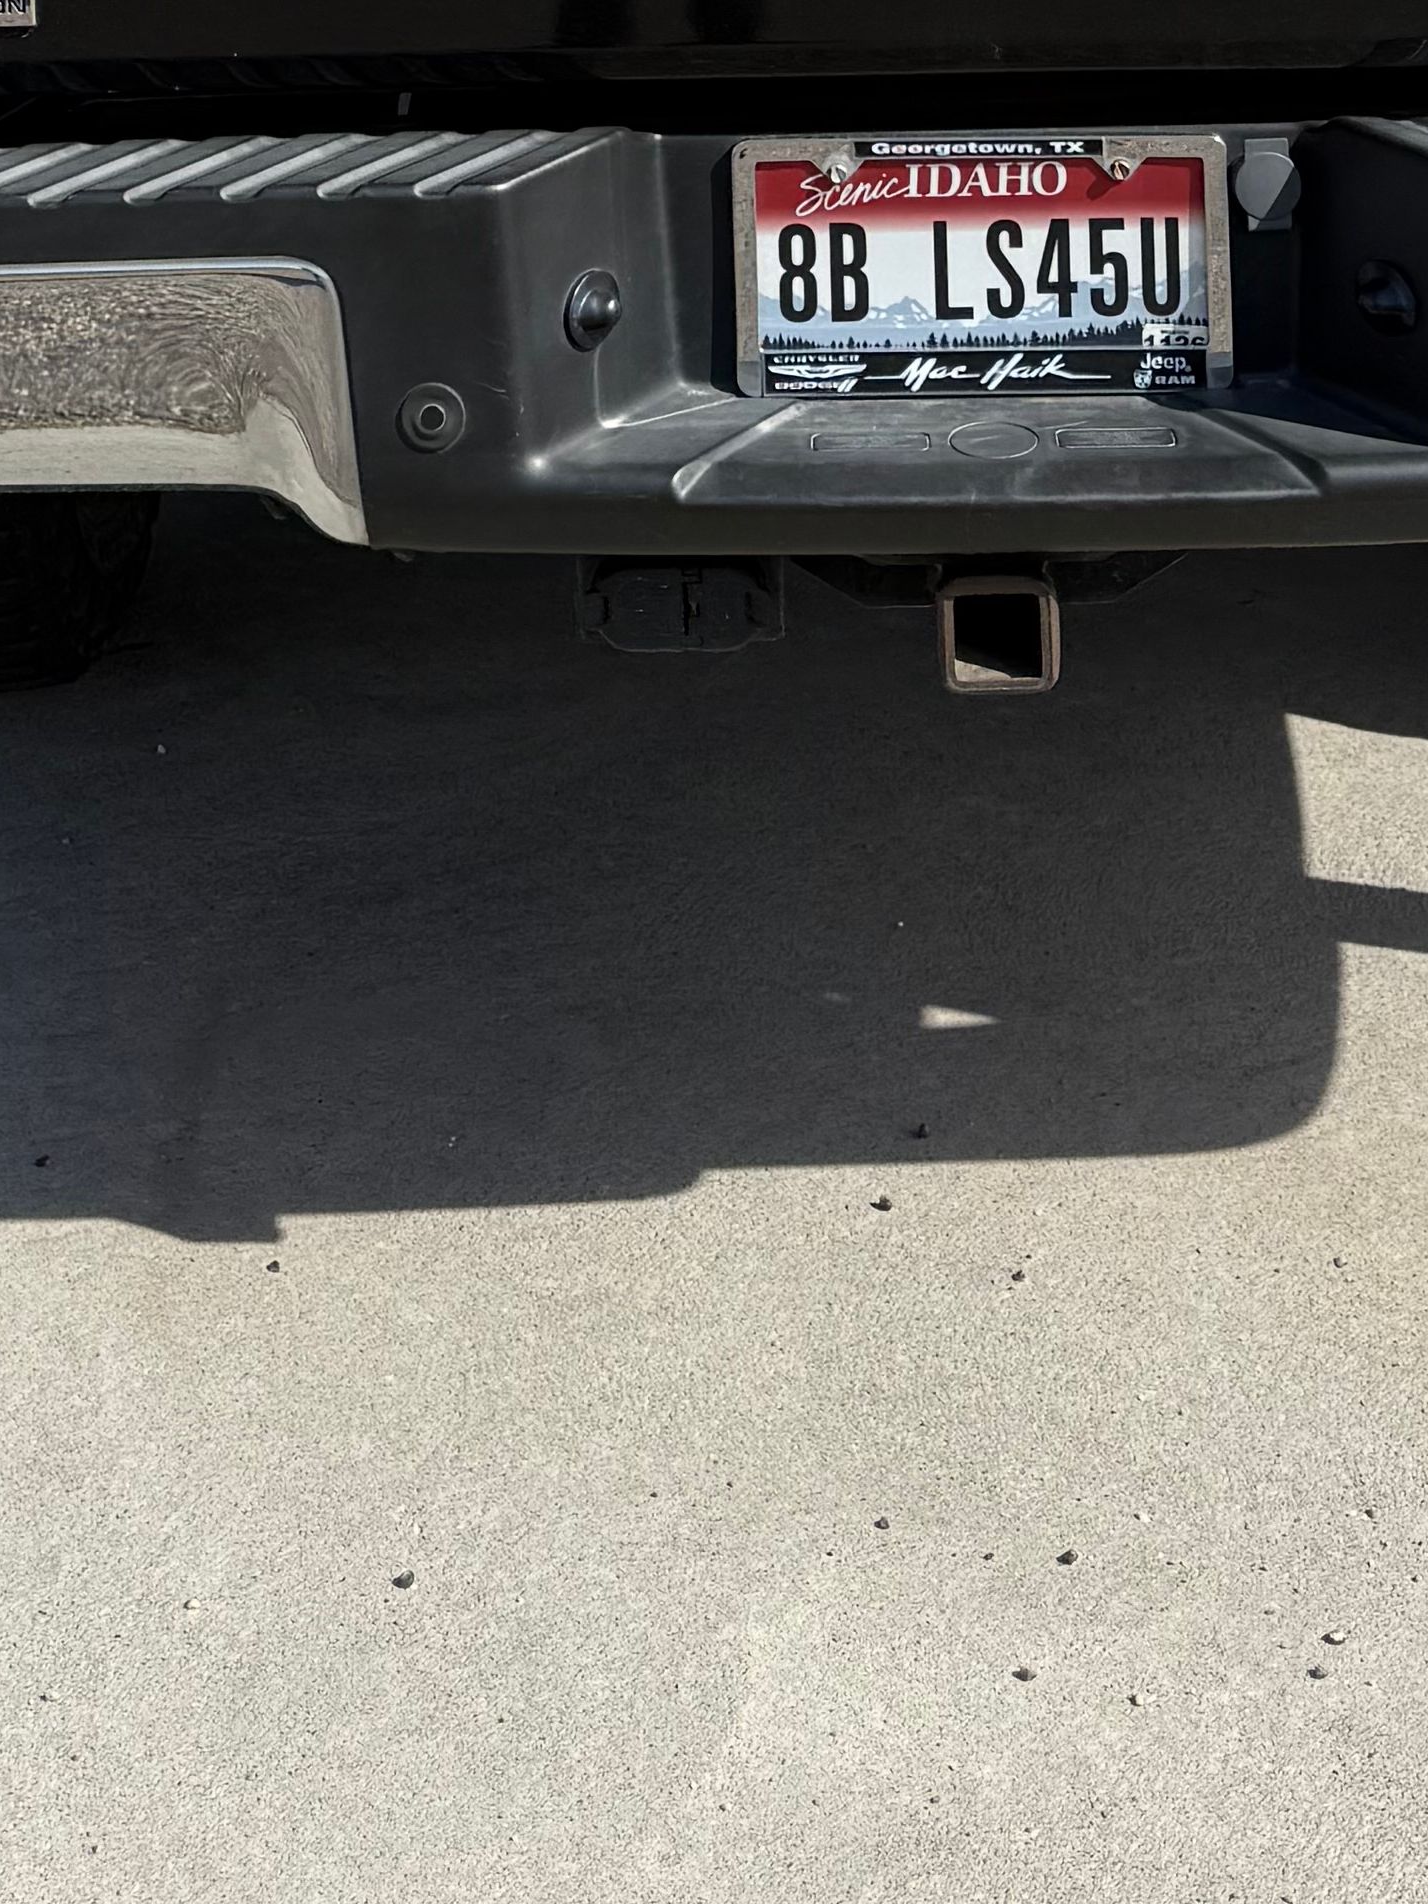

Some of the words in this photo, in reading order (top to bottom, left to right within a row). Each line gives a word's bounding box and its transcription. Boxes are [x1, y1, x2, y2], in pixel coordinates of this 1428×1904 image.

[871, 142, 1042, 156] Georgetown,
[1050, 141, 1085, 154] TX
[795, 173, 909, 217] Scenic
[903, 160, 1068, 198] IDAHO
[778, 222, 870, 323] 8B
[932, 216, 1182, 320] LS45U
[864, 356, 980, 392] Mac
[980, 353, 1112, 390] Haik
